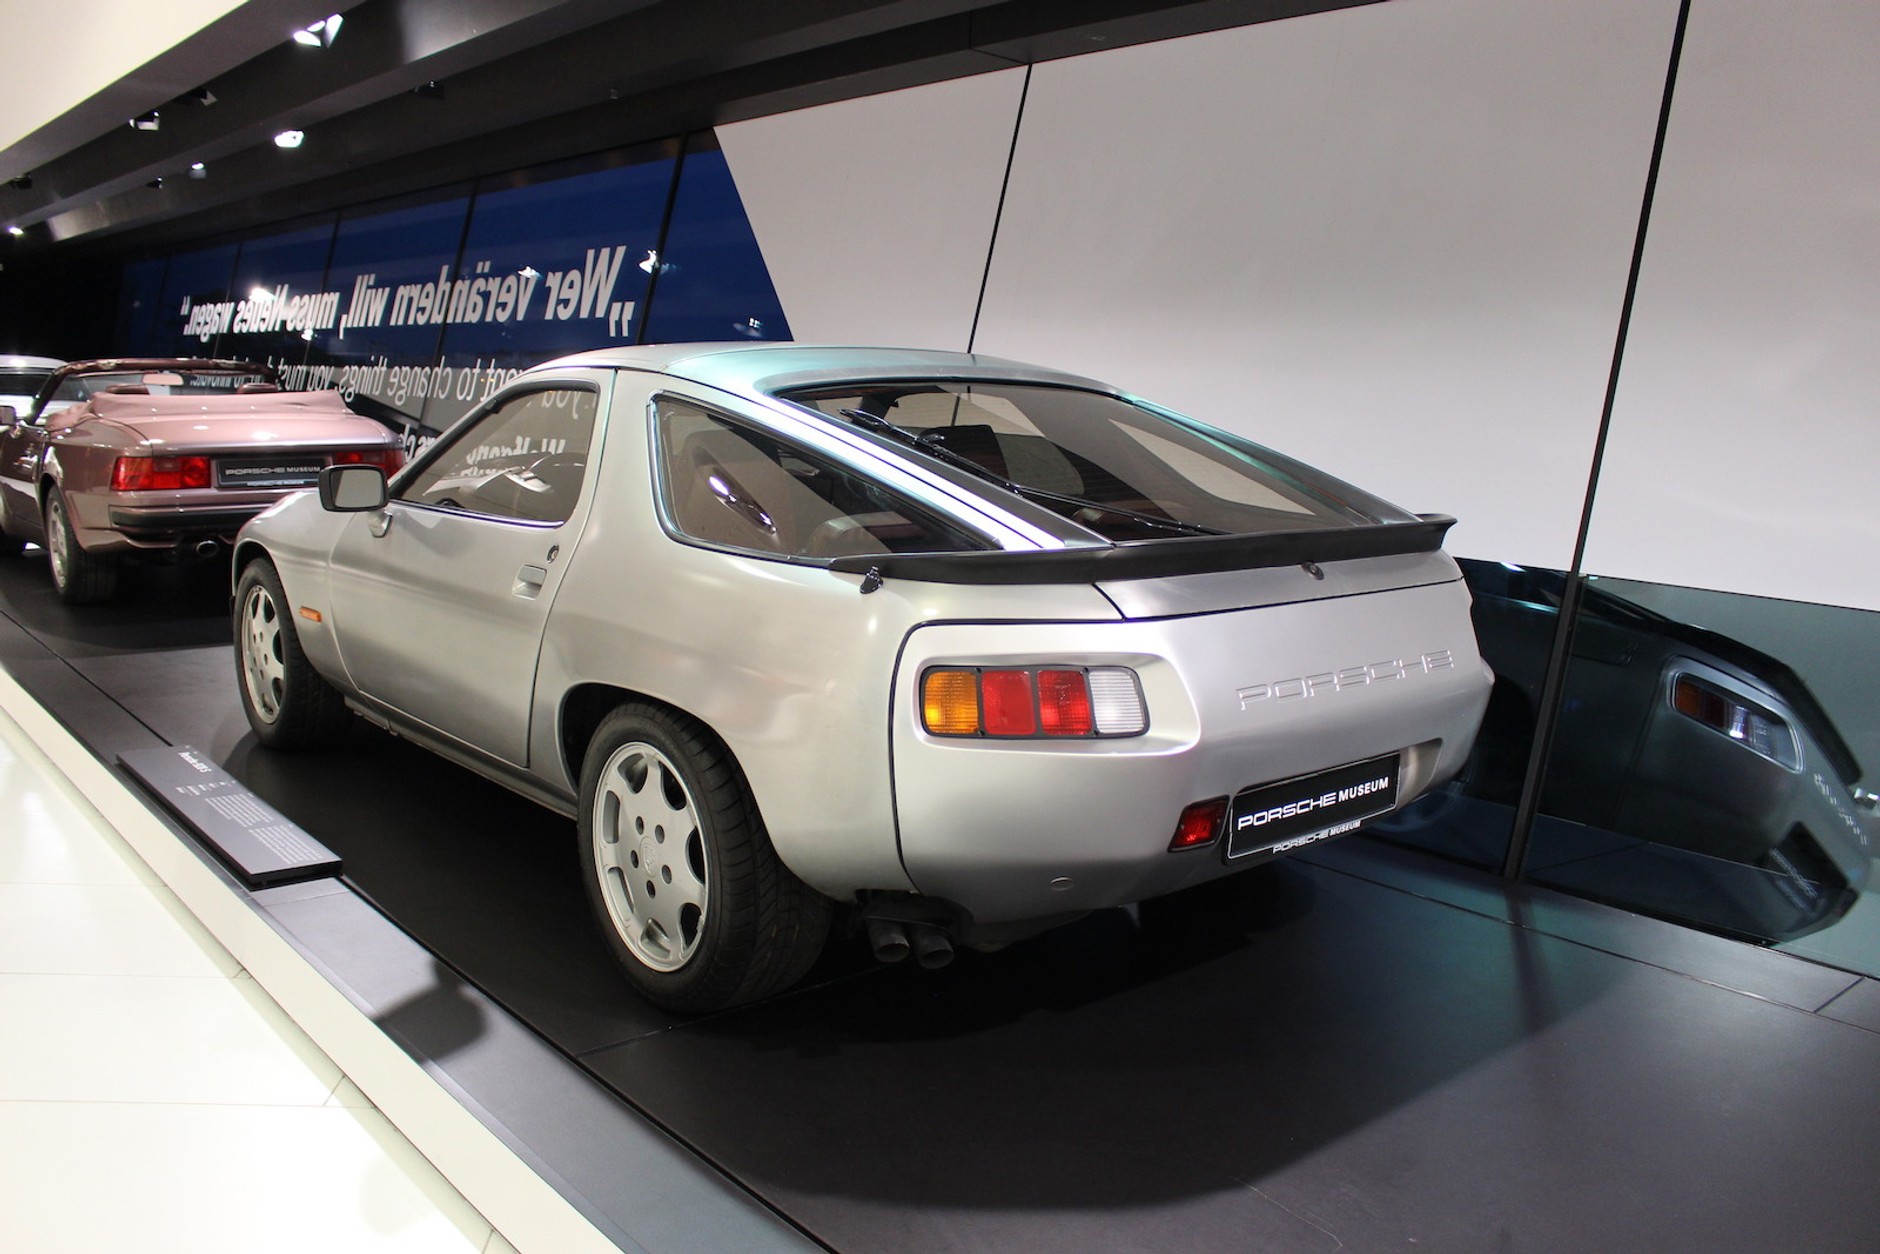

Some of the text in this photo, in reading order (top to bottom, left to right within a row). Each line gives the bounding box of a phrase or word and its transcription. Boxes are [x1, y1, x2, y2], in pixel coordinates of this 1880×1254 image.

[225, 467, 285, 475] PORSCHE
[1236, 650, 1454, 711] PORSCHE
[1237, 777, 1390, 831] PORSCHE MUSEUM
[1272, 820, 1362, 854] PORSCHE MUSEUM
